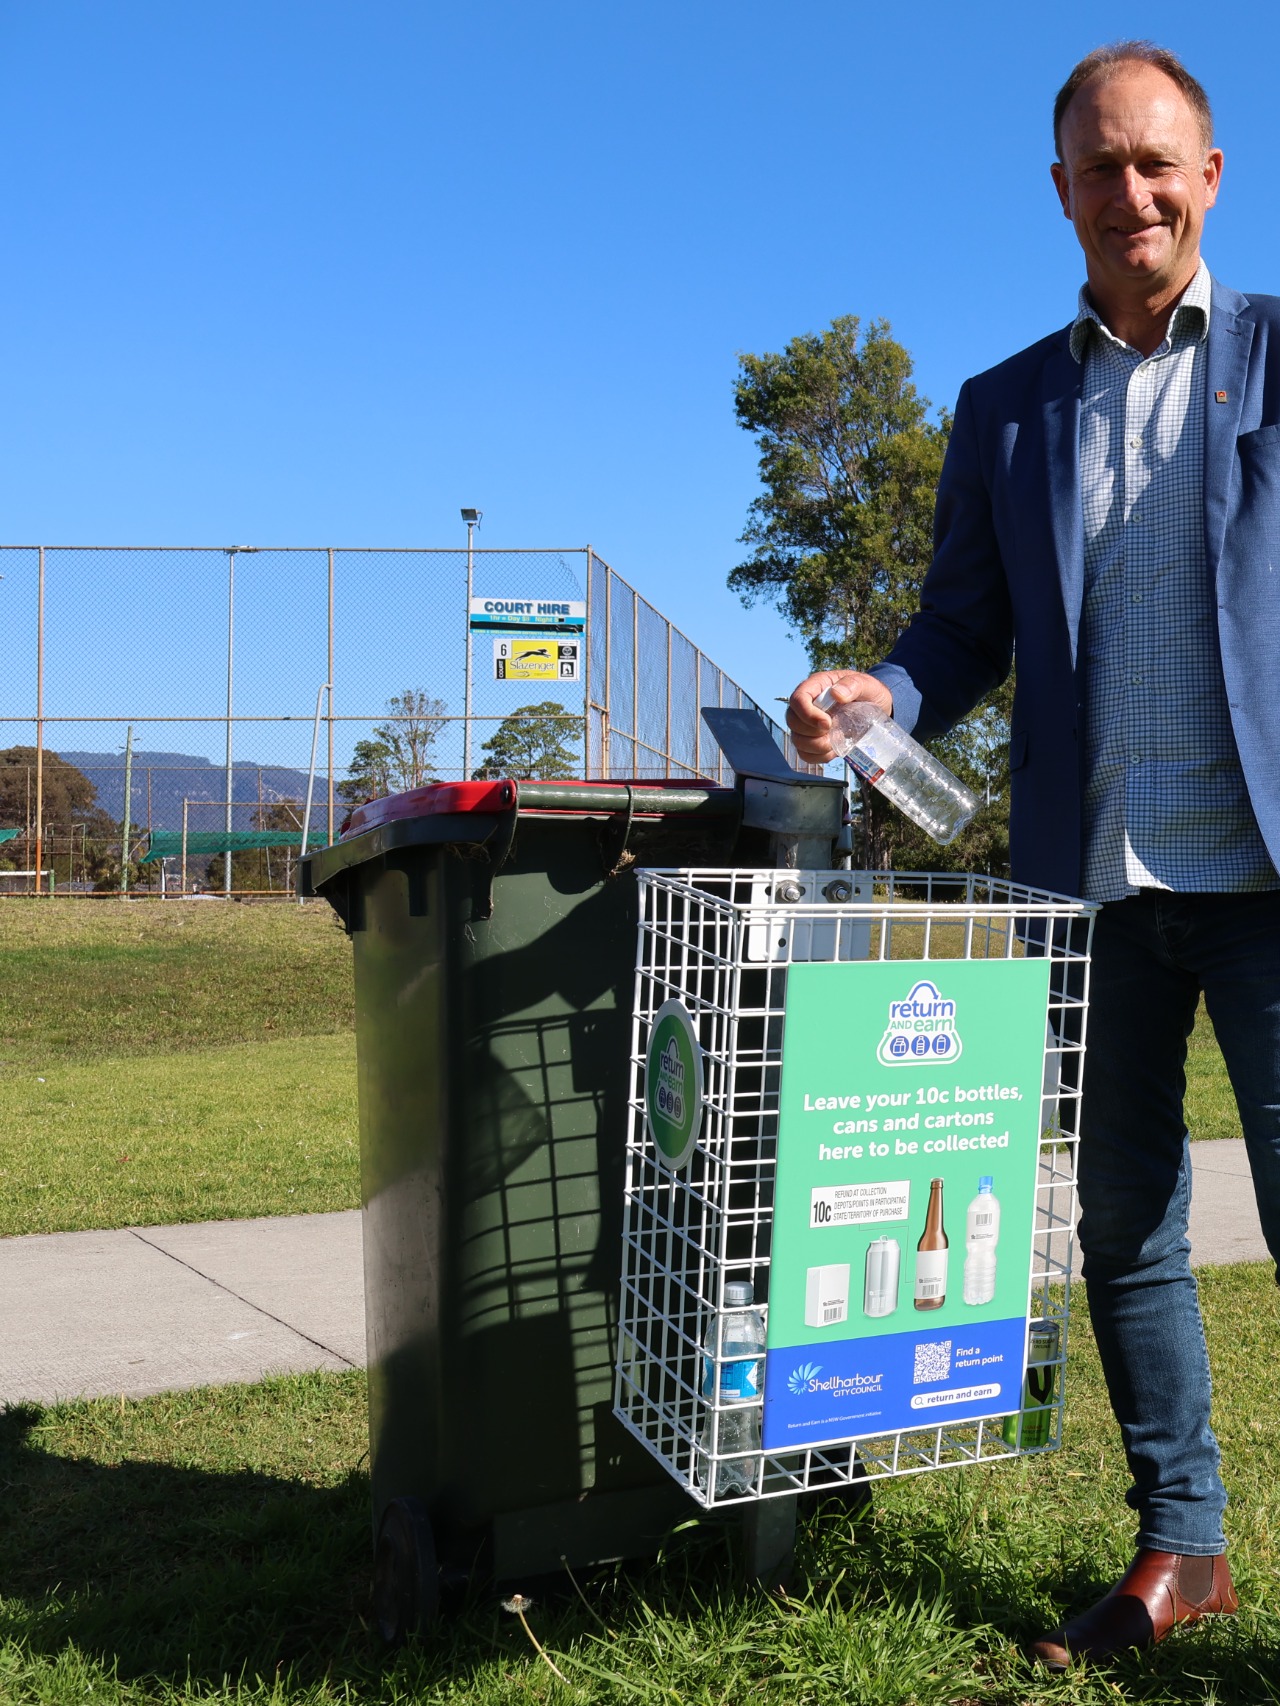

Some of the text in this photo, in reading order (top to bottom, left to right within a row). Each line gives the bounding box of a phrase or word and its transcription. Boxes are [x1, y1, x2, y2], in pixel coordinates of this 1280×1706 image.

[484, 601, 570, 614] COURT HIRE
[500, 644, 507, 656] 6
[510, 661, 555, 671] Slazenger
[891, 999, 953, 1018] return
[890, 1018, 952, 1032] AND earn
[660, 1054, 684, 1080] return
[668, 1076, 683, 1093] earn
[804, 1084, 1023, 1112] Leave your 10c bottles,
[833, 1110, 994, 1135] cans and cartons
[818, 1132, 1009, 1160] here to be collected
[834, 1190, 853, 1198] REFUND
[860, 1187, 887, 1196] COLLECTION
[834, 1199, 869, 1210] DEPOTS/POINTS
[875, 1196, 906, 1206] PARTICIPATING
[813, 1201, 831, 1223] 10c
[833, 1210, 872, 1221] STATE/TERRITORY
[880, 1207, 903, 1216] PURCHASE
[956, 1348, 972, 1357] Find
[955, 1355, 1003, 1368] return point
[808, 1372, 884, 1393] Shellharbour
[1027, 1365, 1052, 1404] V
[833, 1385, 882, 1398] CITY COUNCIL
[927, 1388, 992, 1404] return and earn
